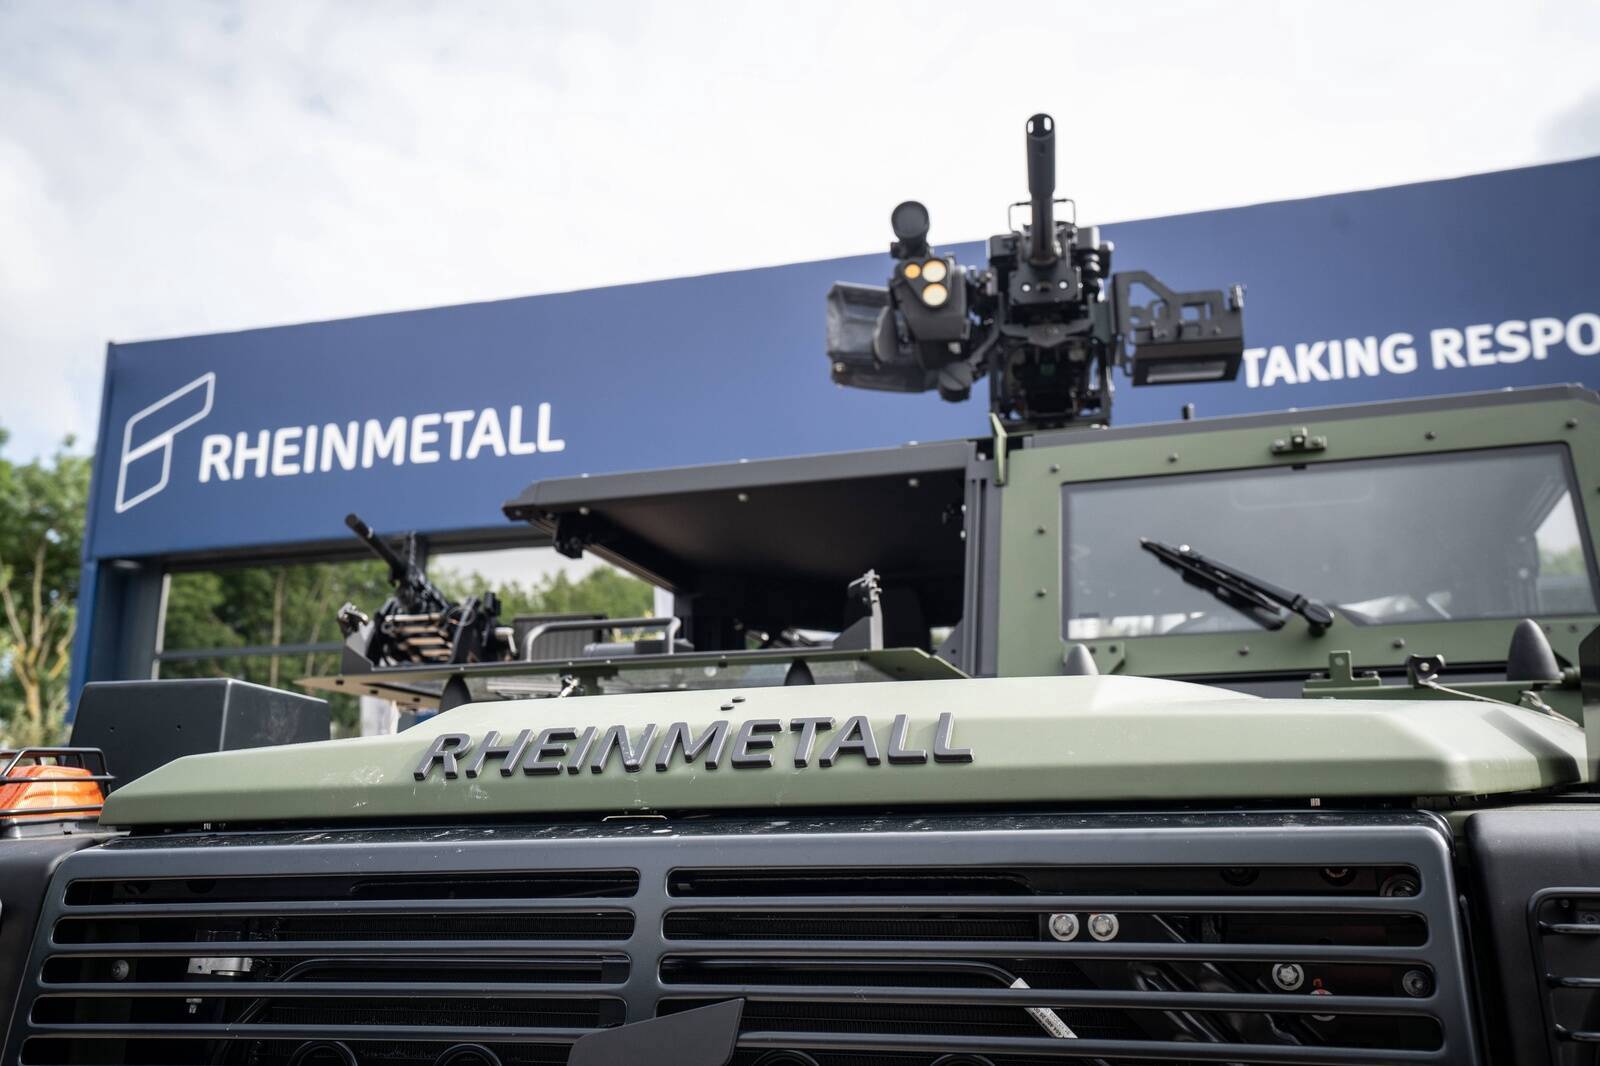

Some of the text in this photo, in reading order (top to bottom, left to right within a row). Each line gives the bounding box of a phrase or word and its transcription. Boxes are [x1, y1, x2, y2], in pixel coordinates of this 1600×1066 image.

[1242, 313, 1600, 388] TAKING RESPO
[198, 402, 566, 484] RHEINMETALL
[413, 712, 974, 780] RHEINMETALL
